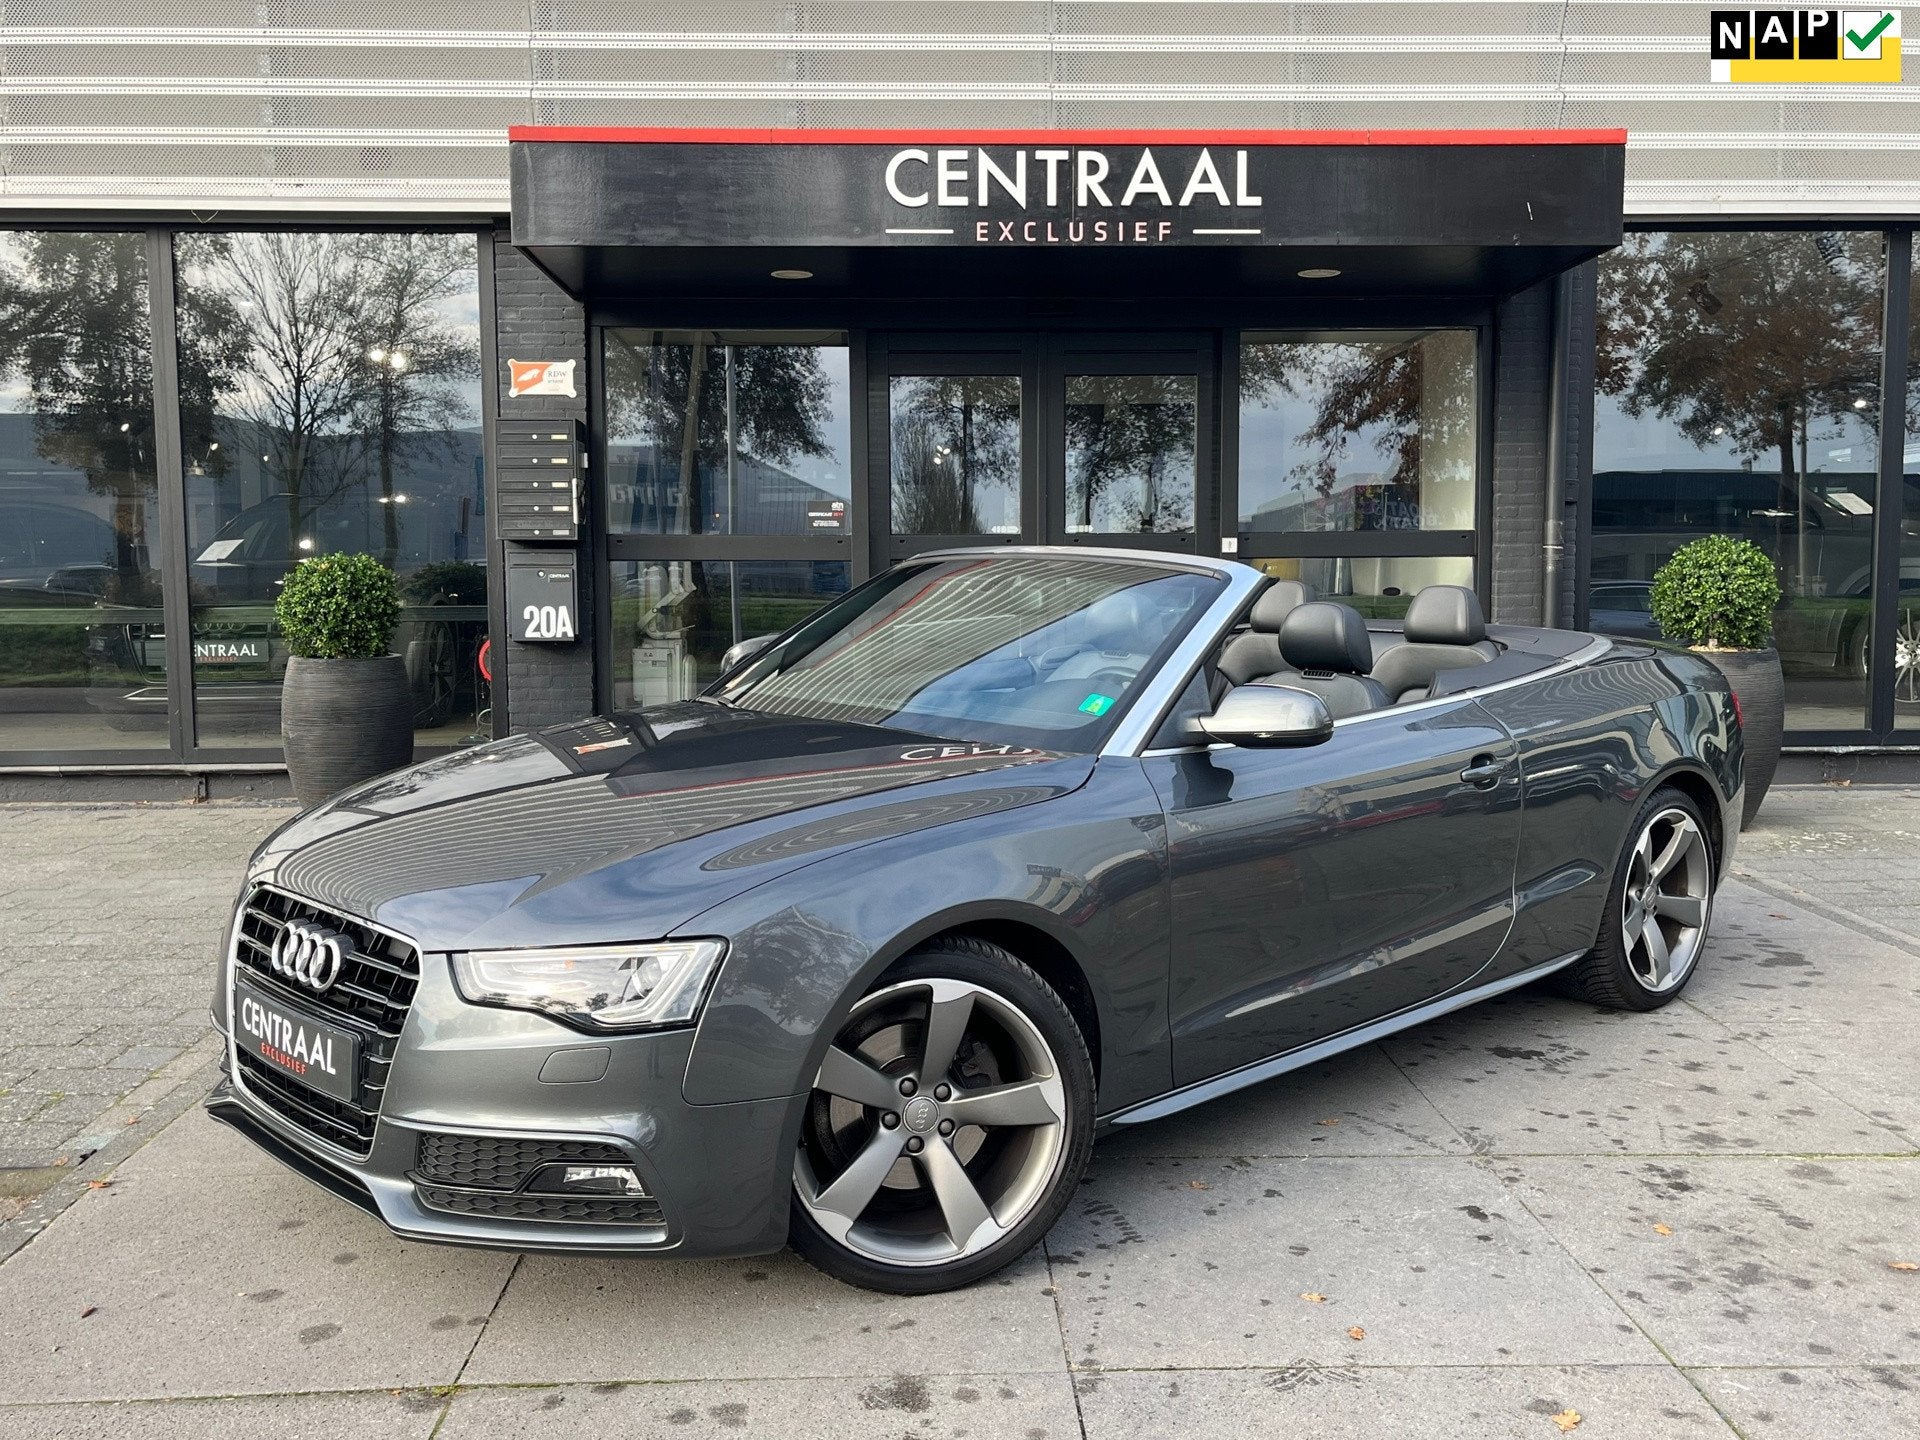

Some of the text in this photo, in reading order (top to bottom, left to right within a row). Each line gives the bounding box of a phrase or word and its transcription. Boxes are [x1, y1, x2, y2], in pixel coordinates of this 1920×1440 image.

[885, 147, 1262, 210] CENTRAAL
[975, 221, 1173, 242] EXCLUSIEF
[547, 370, 567, 378] RDW
[523, 605, 574, 638] 20A
[242, 997, 336, 1075] CENTRAAL
[261, 1042, 306, 1074] EXCLUSIEF
